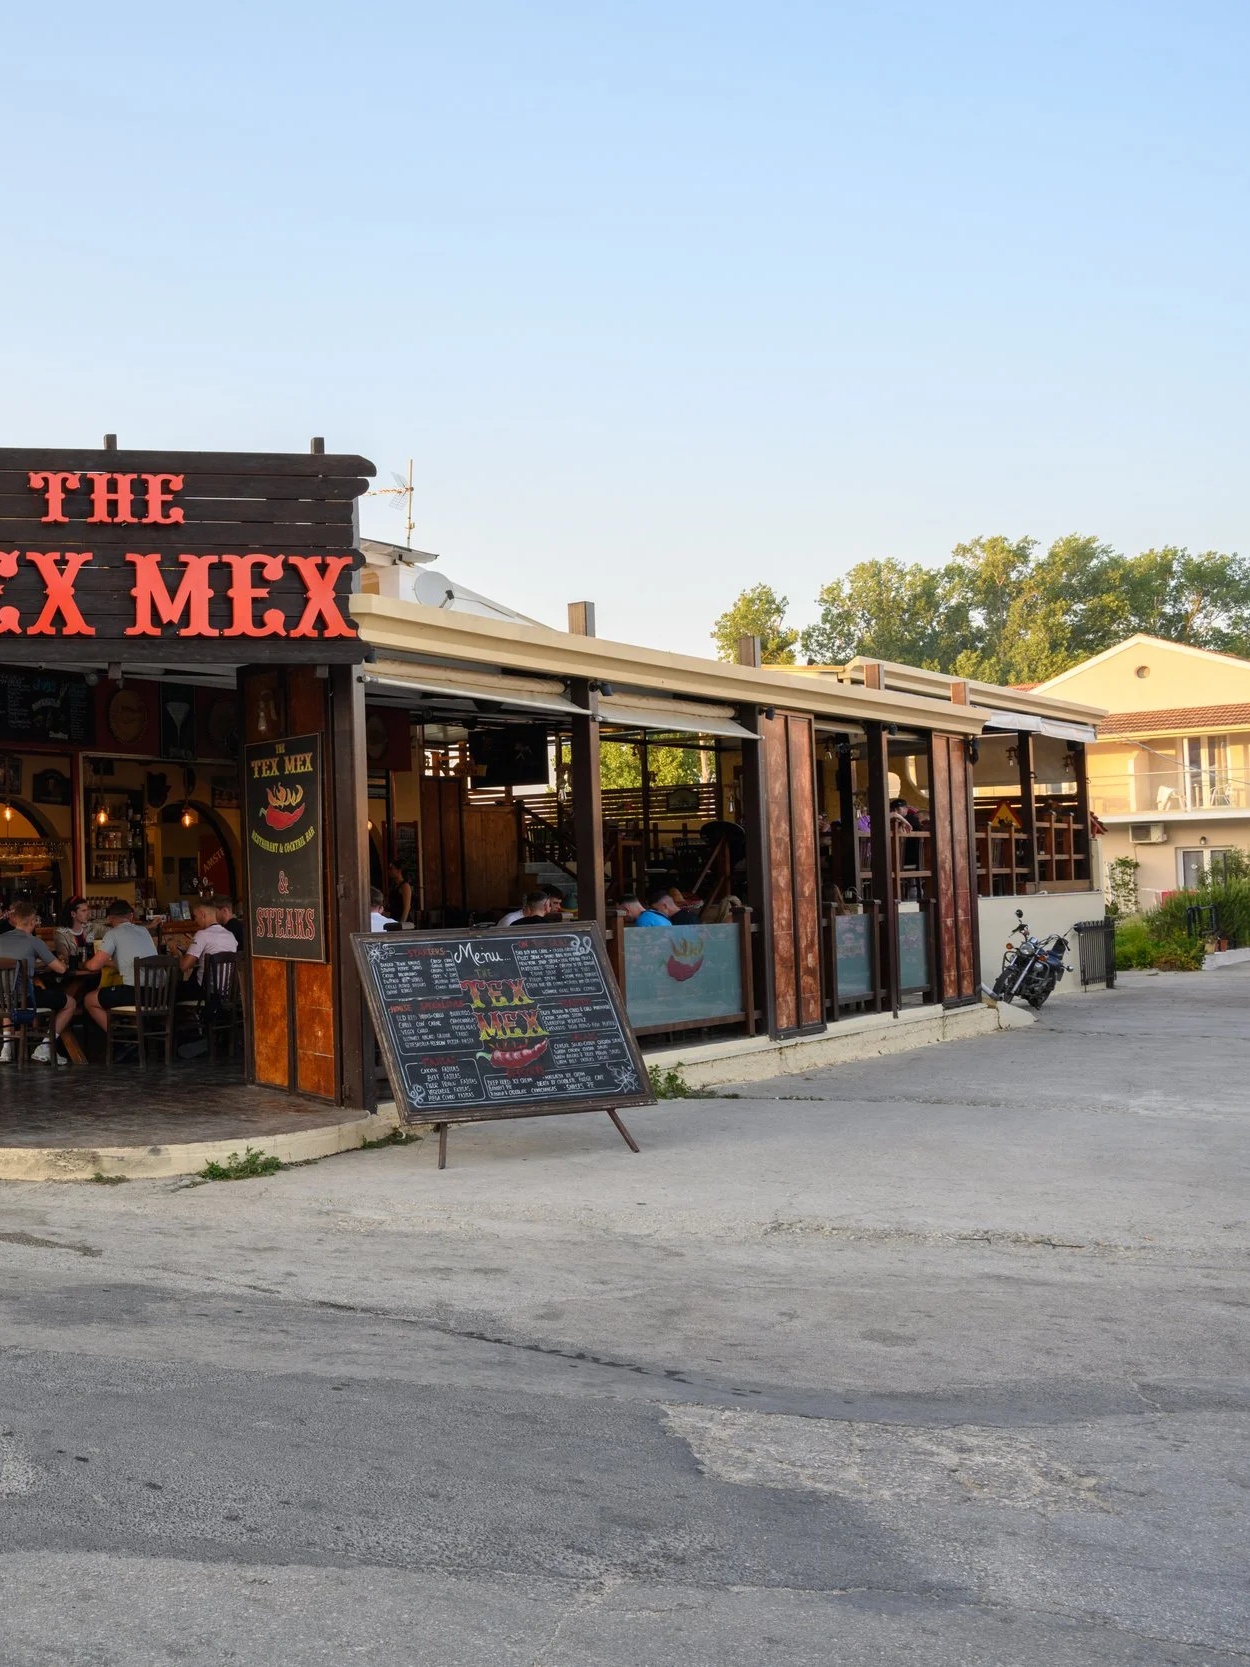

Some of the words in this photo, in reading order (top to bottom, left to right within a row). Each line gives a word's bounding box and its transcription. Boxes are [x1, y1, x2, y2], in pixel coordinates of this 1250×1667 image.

[28, 472, 185, 525] THE
[124, 553, 358, 638] MEX
[275, 743, 285, 754] THE
[251, 758, 280, 779] TEX
[284, 752, 313, 774] MEX
[251, 829, 279, 853] RESTAURANT
[284, 836, 306, 853] COCKTAIL
[305, 825, 315, 842] BAR
[278, 870, 289, 894] &
[256, 906, 316, 941] STEAKS
[474, 967, 494, 979] THE
[460, 977, 534, 1008] TEX
[473, 1009, 549, 1040] MEX
